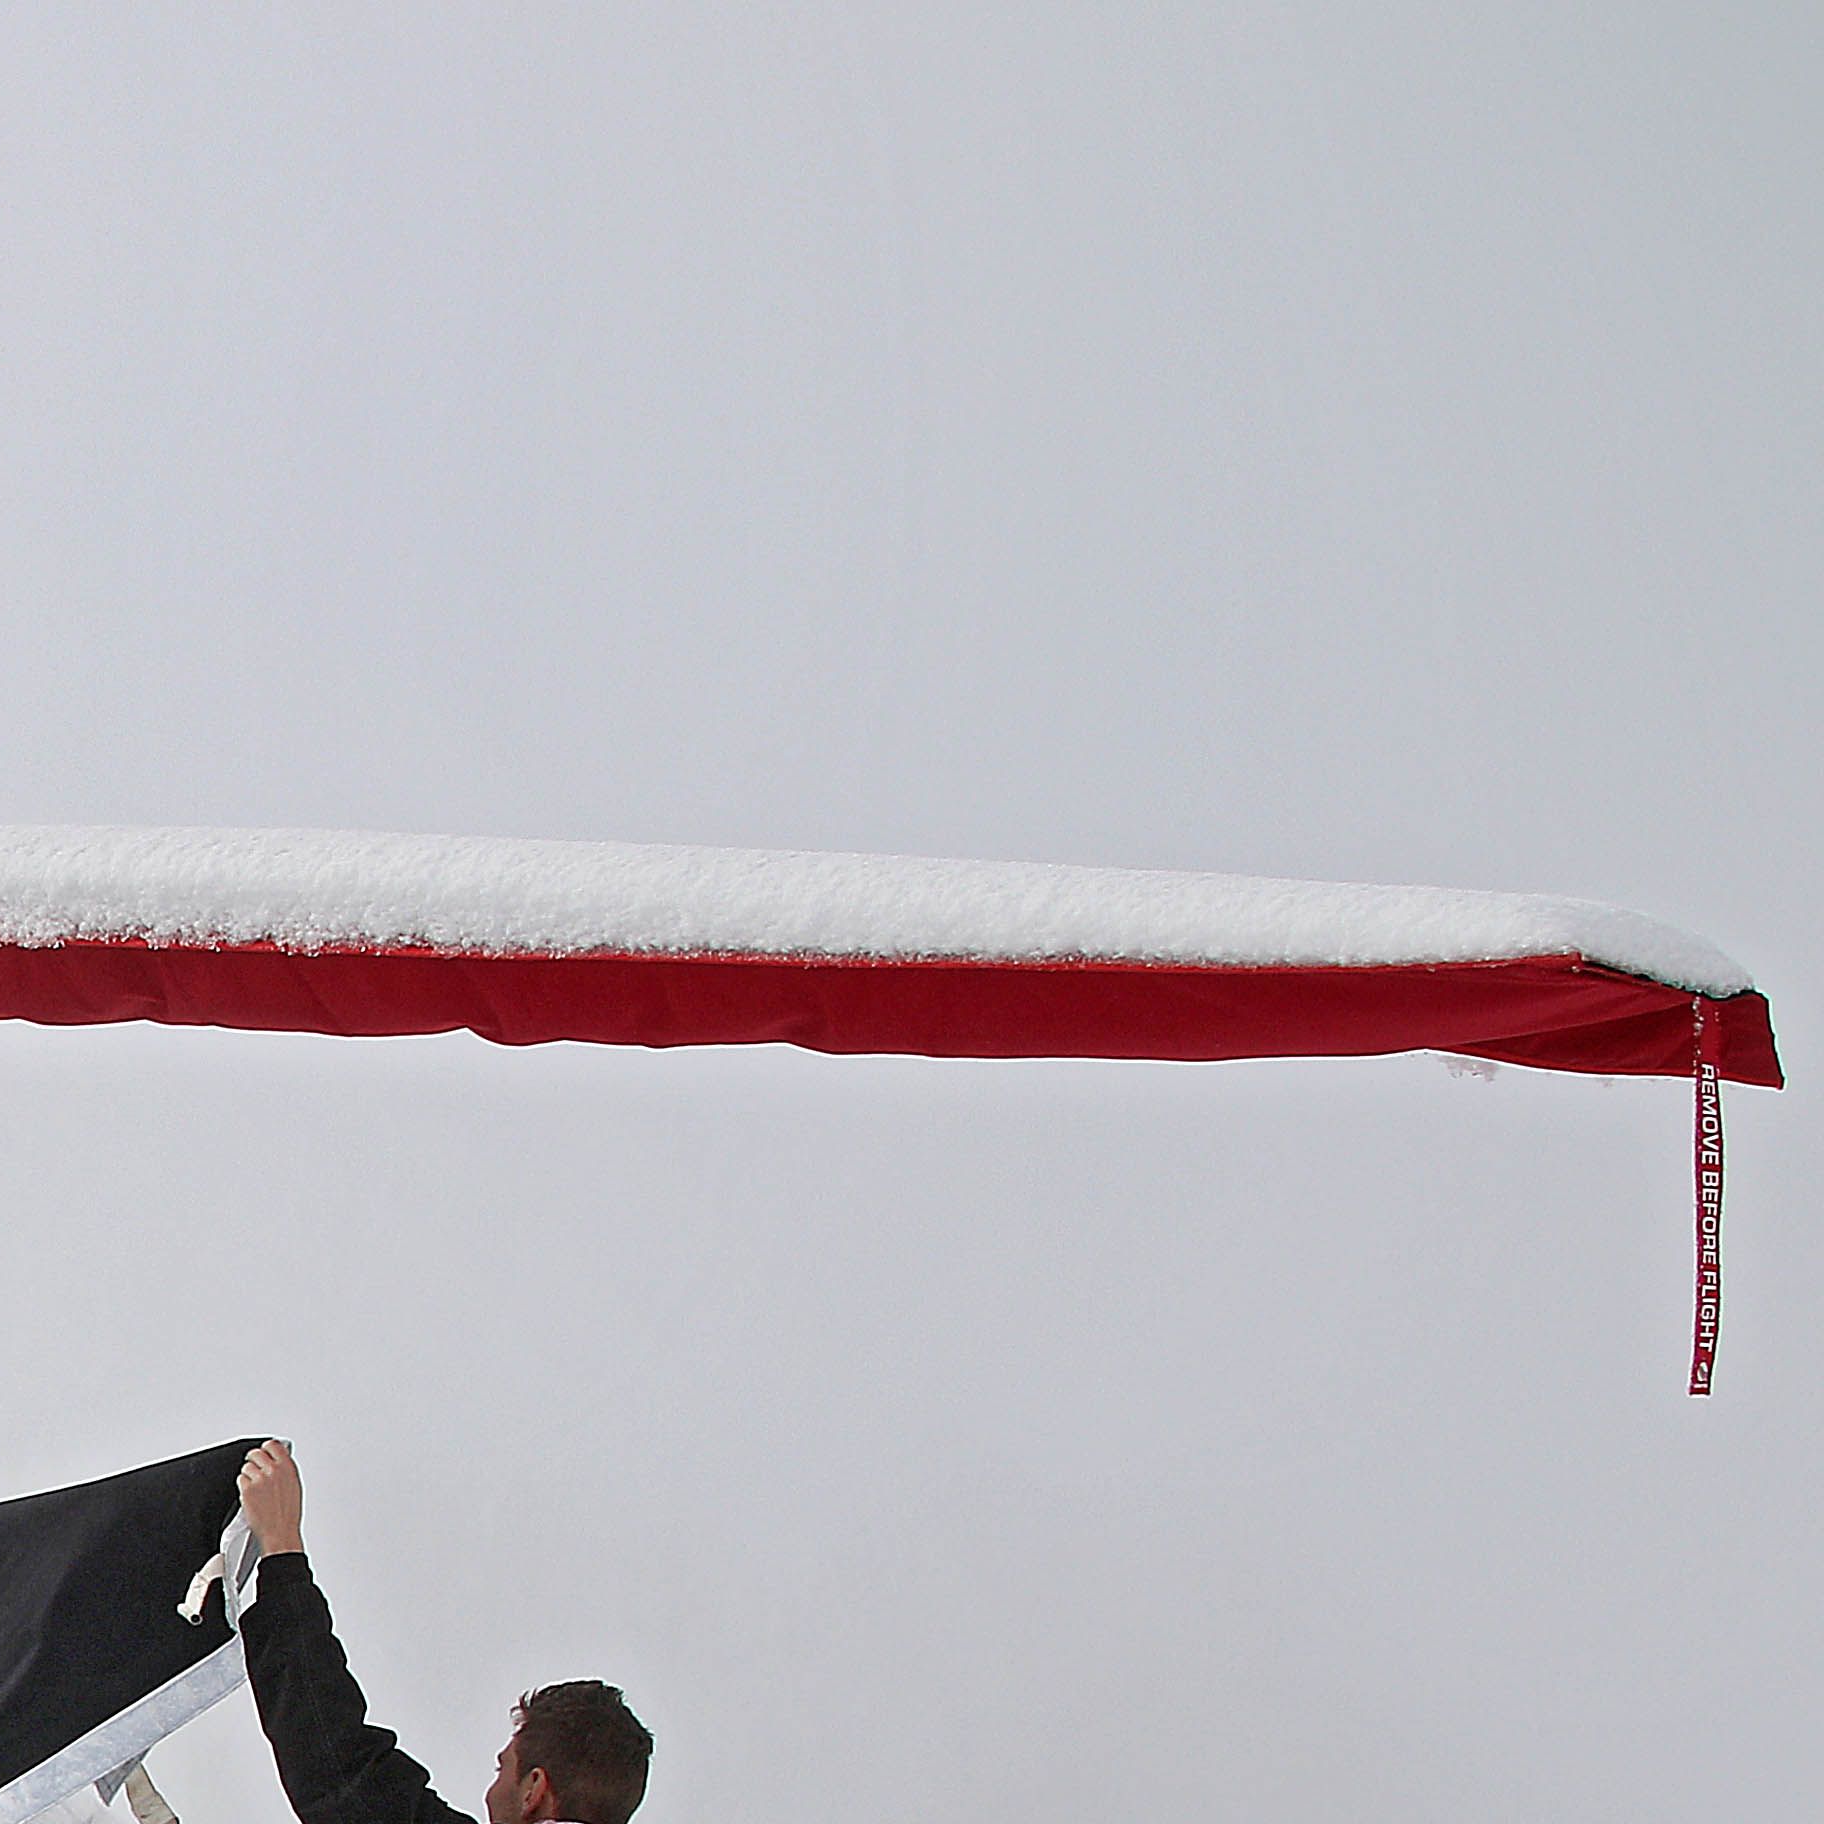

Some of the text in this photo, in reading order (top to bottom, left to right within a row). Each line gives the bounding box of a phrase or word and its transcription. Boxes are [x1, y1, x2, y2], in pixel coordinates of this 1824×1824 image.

[1698, 1063, 1720, 1353] REMOVE BEFORE FLIGHT
